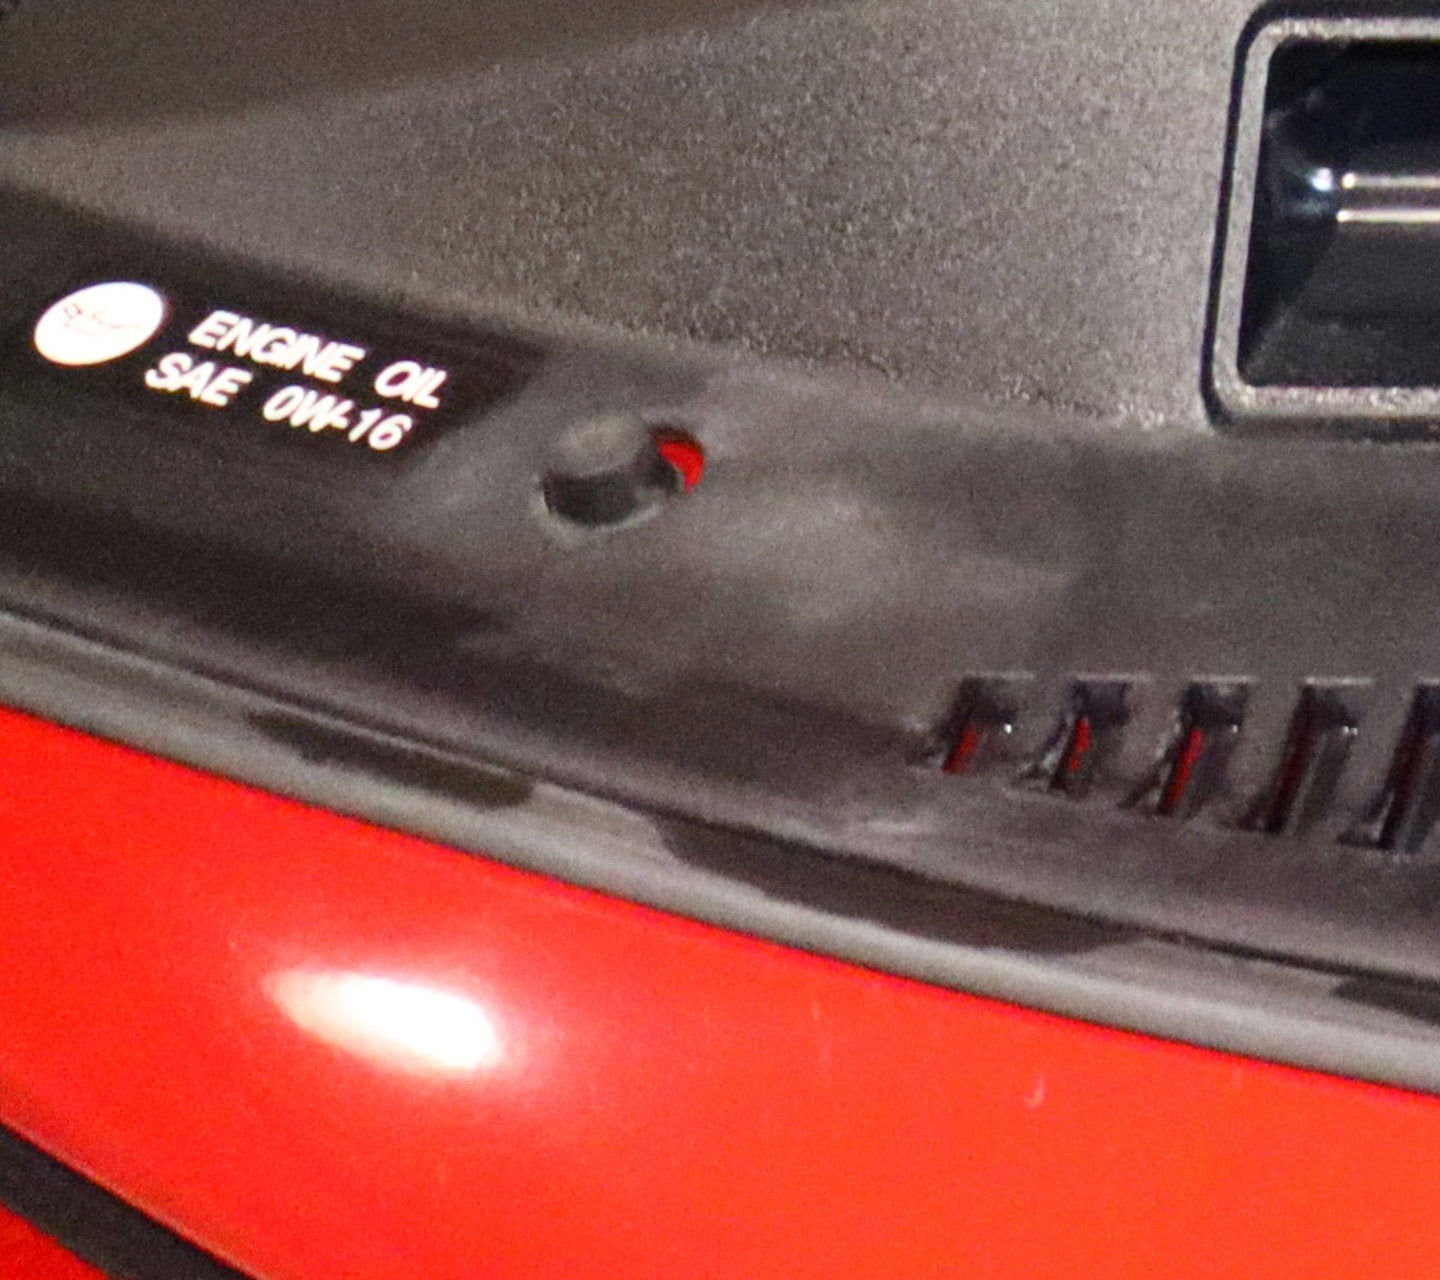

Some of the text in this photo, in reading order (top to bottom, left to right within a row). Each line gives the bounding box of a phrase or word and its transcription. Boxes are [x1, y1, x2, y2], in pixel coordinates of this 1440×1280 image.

[145, 352, 413, 451] SAE 0W-16
[188, 310, 447, 409] ENGINE OIL
